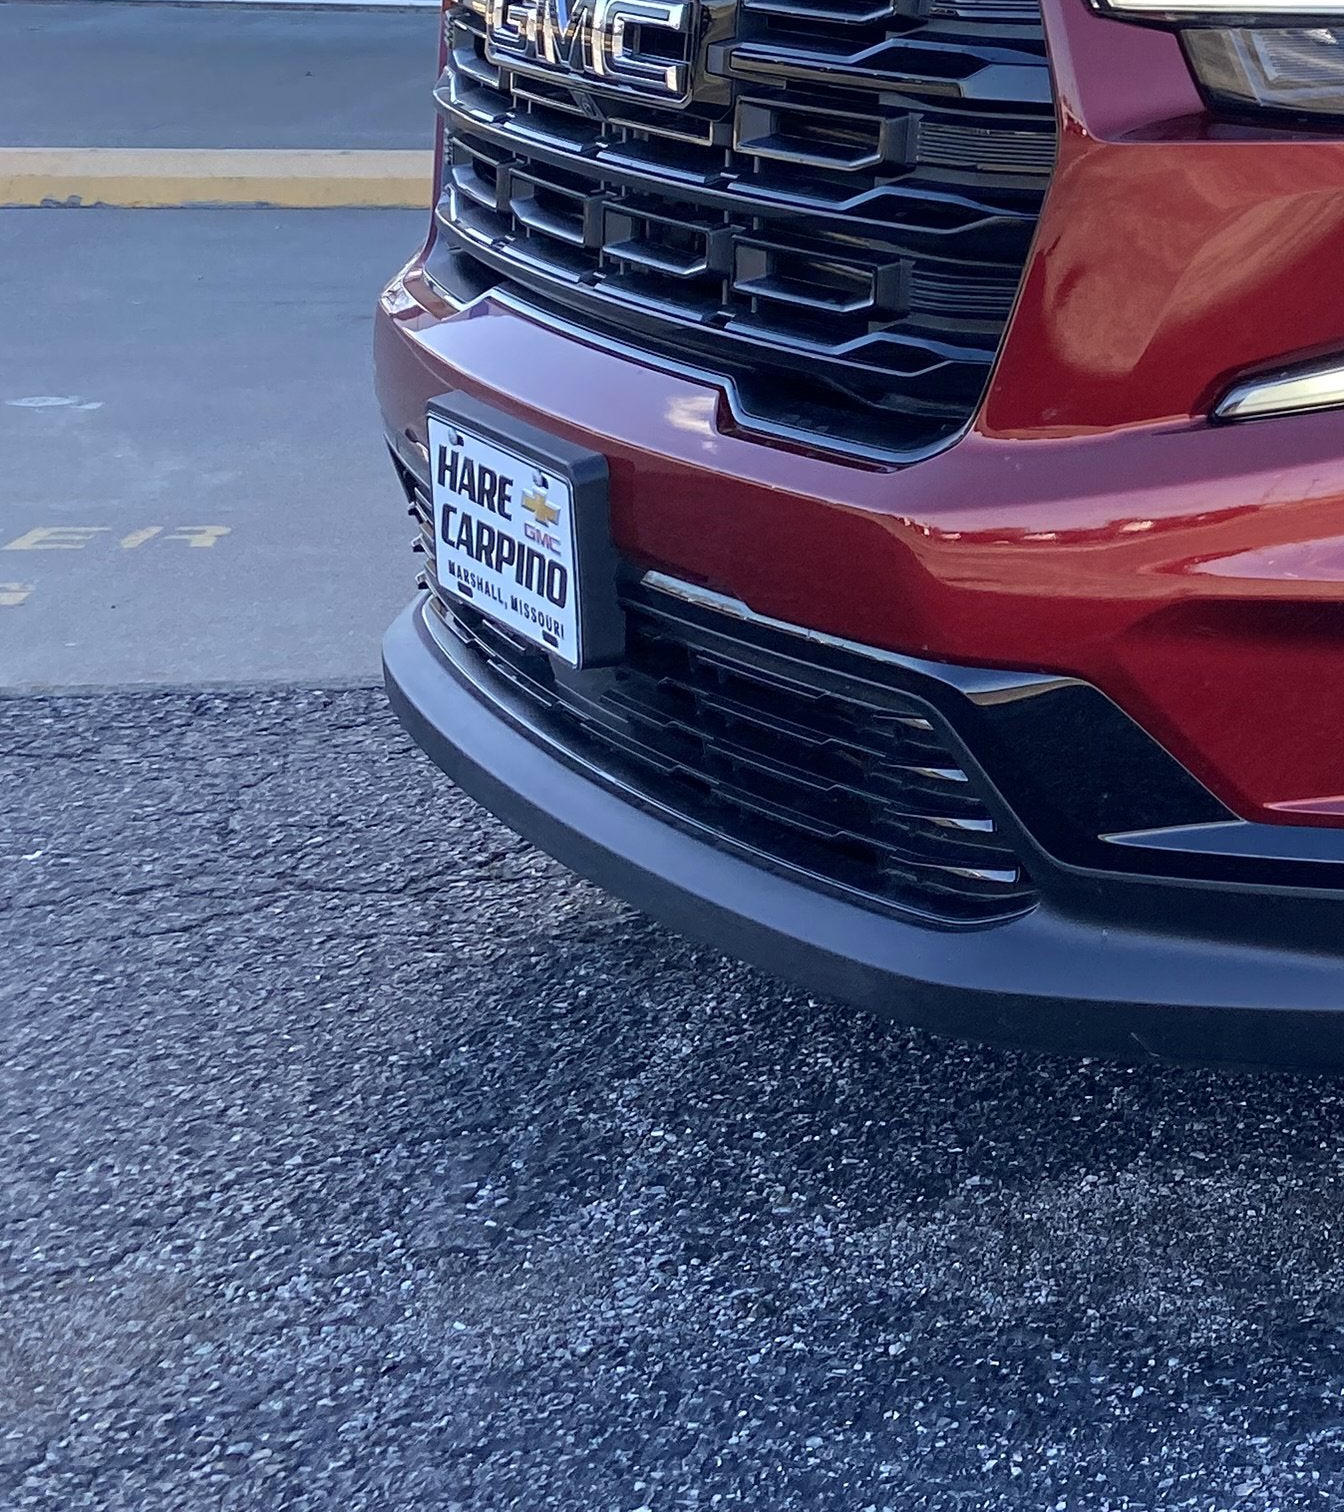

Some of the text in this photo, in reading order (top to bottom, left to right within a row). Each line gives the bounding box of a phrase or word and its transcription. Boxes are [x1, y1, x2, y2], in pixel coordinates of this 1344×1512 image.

[437, 444, 513, 521] HARE
[441, 503, 568, 609] CARPINO
[524, 522, 562, 556] GMC
[448, 559, 564, 639] MARSHALL, MISSOURI
